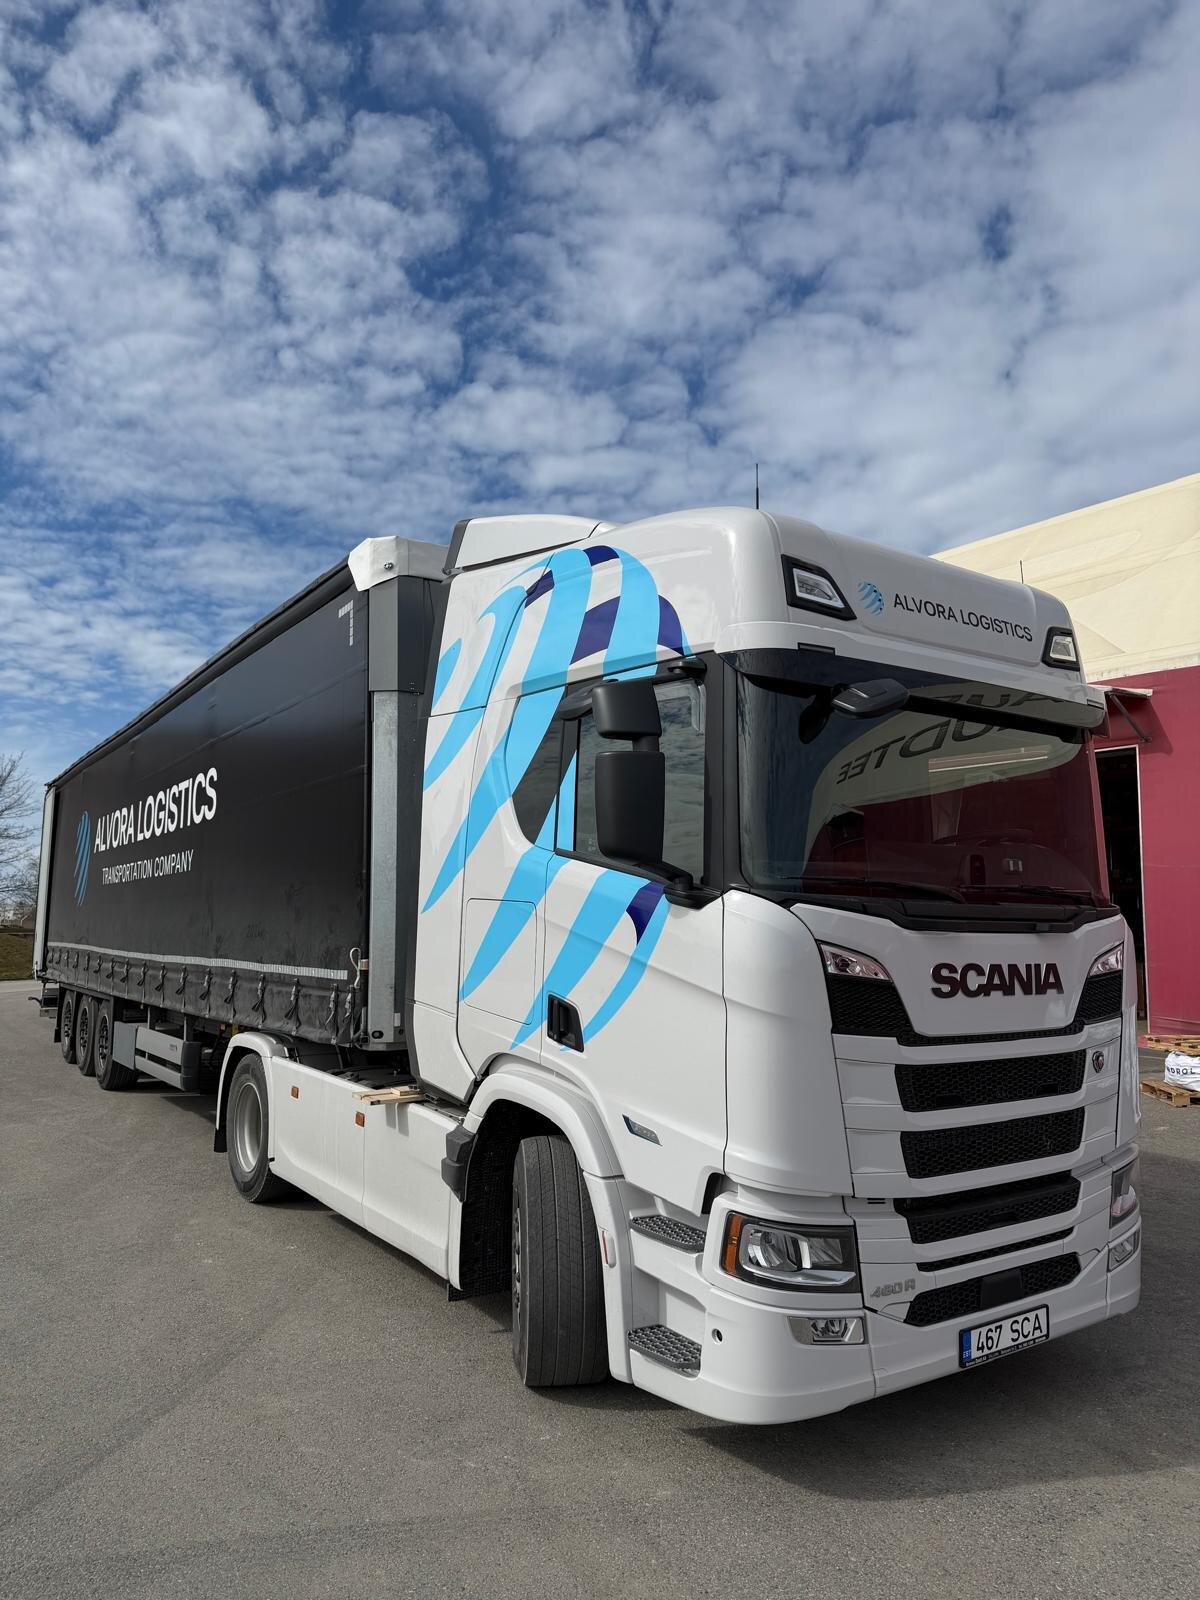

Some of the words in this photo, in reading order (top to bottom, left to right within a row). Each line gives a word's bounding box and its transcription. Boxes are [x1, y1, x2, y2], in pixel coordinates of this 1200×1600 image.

[893, 593, 958, 622] ALVORA
[960, 609, 1032, 641] LOGISTICS
[94, 804, 135, 853] ALVORA
[136, 767, 217, 841] LOGISTICS
[102, 859, 152, 885] TRANSPORTATION
[153, 849, 193, 877] COMPANY
[930, 962, 1064, 998] SCANIA
[976, 1325, 1003, 1353] 467
[1010, 1313, 1043, 1343] SCA
